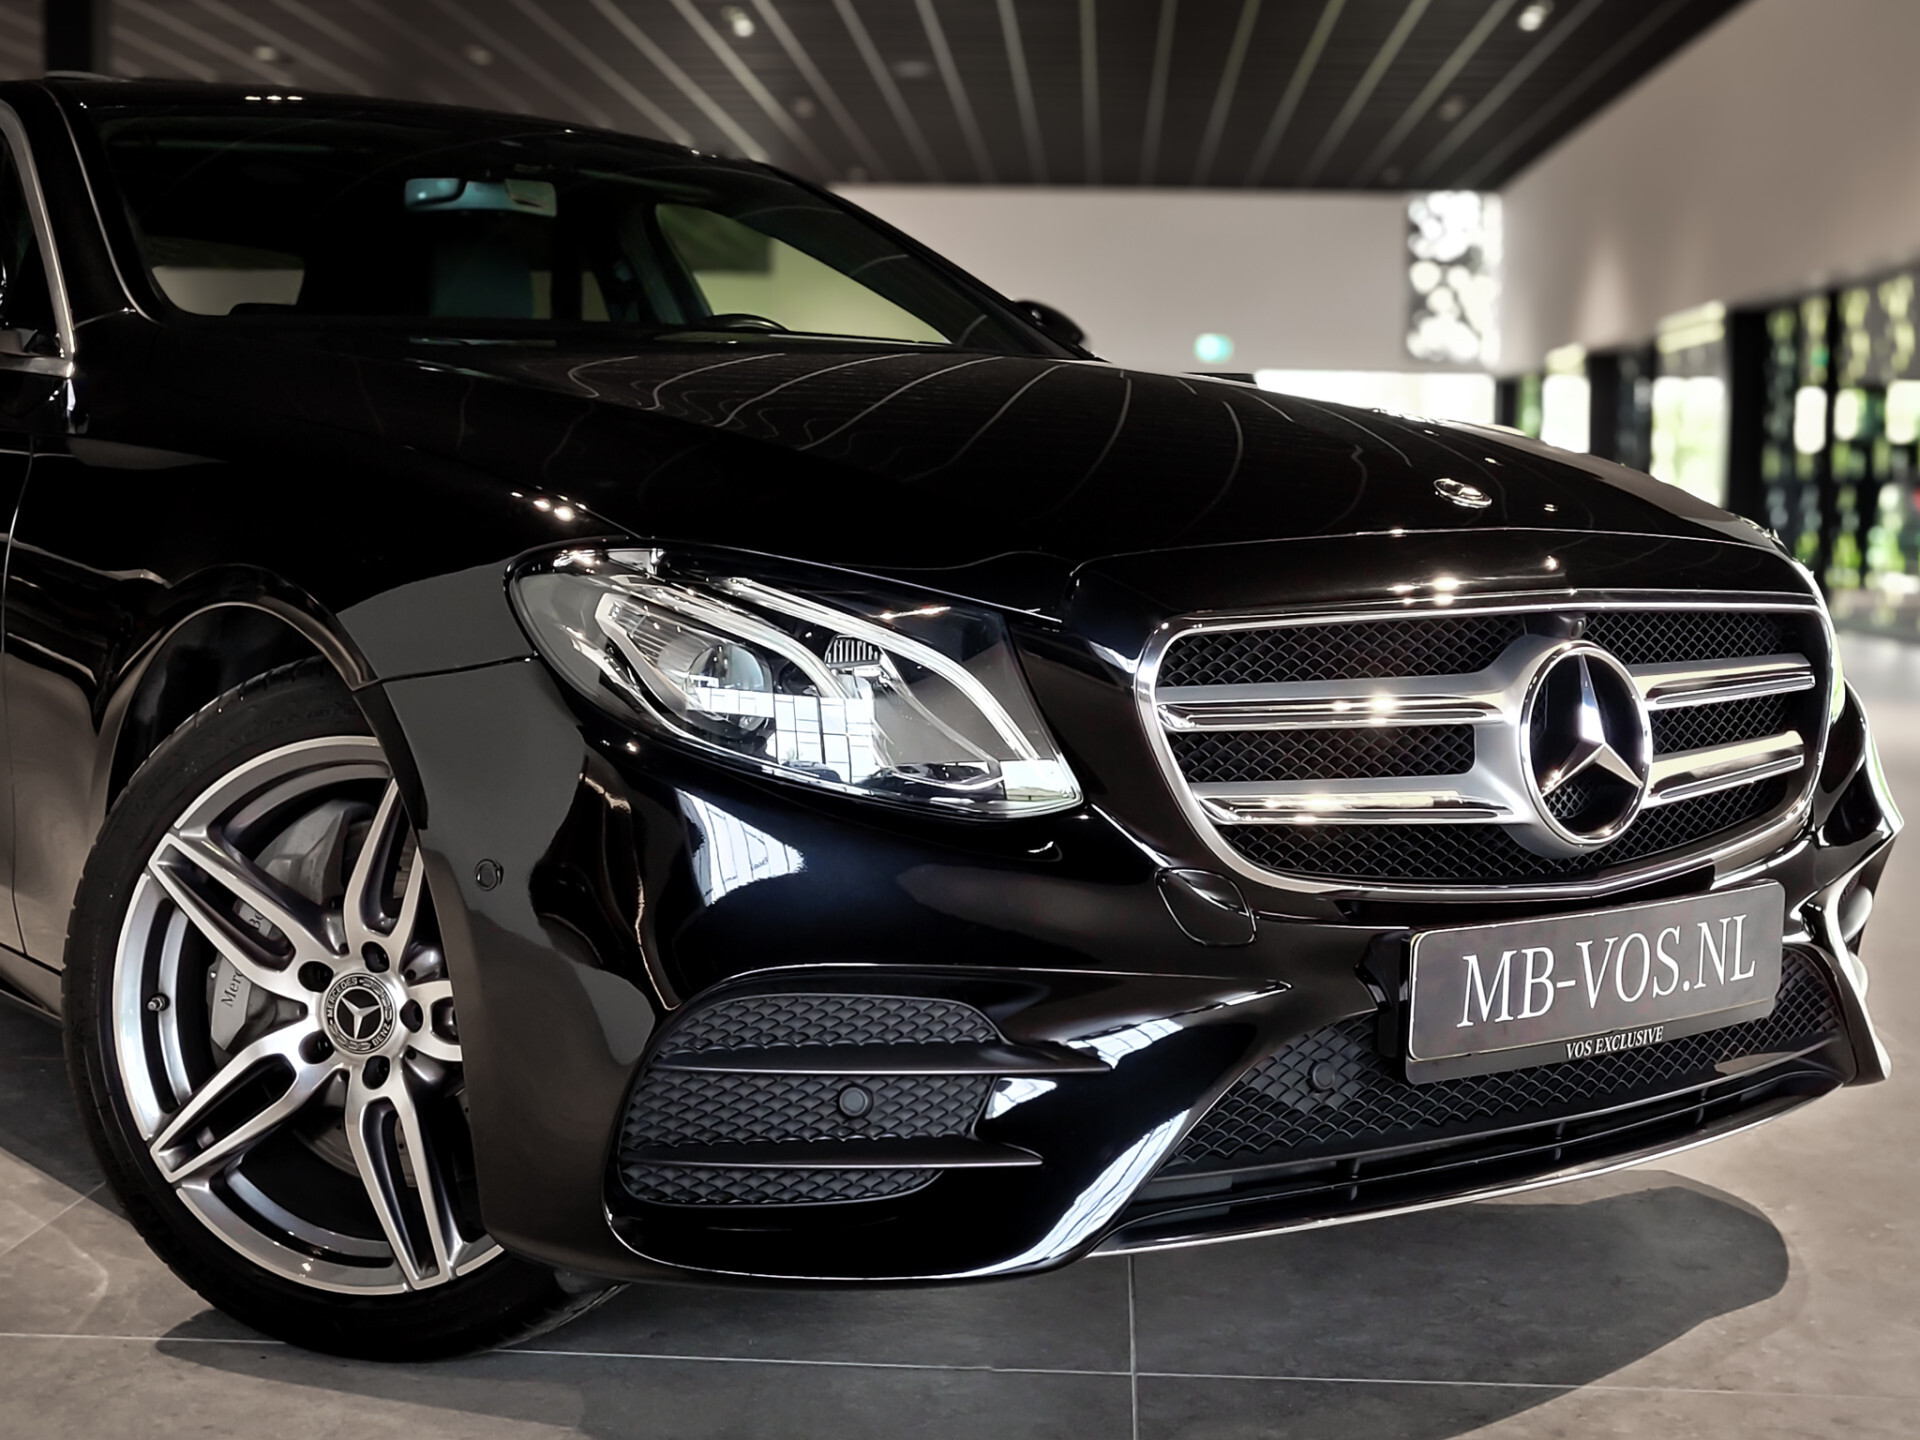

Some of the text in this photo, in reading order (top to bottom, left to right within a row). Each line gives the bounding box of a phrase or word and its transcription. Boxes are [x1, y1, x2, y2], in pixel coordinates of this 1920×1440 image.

[1456, 914, 1756, 1028] MB-VOS.NL
[327, 977, 358, 1018] MERCEDES
[371, 1022, 391, 1046] BENZ
[1566, 1025, 1664, 1060] VOS EXCLUSIVE
